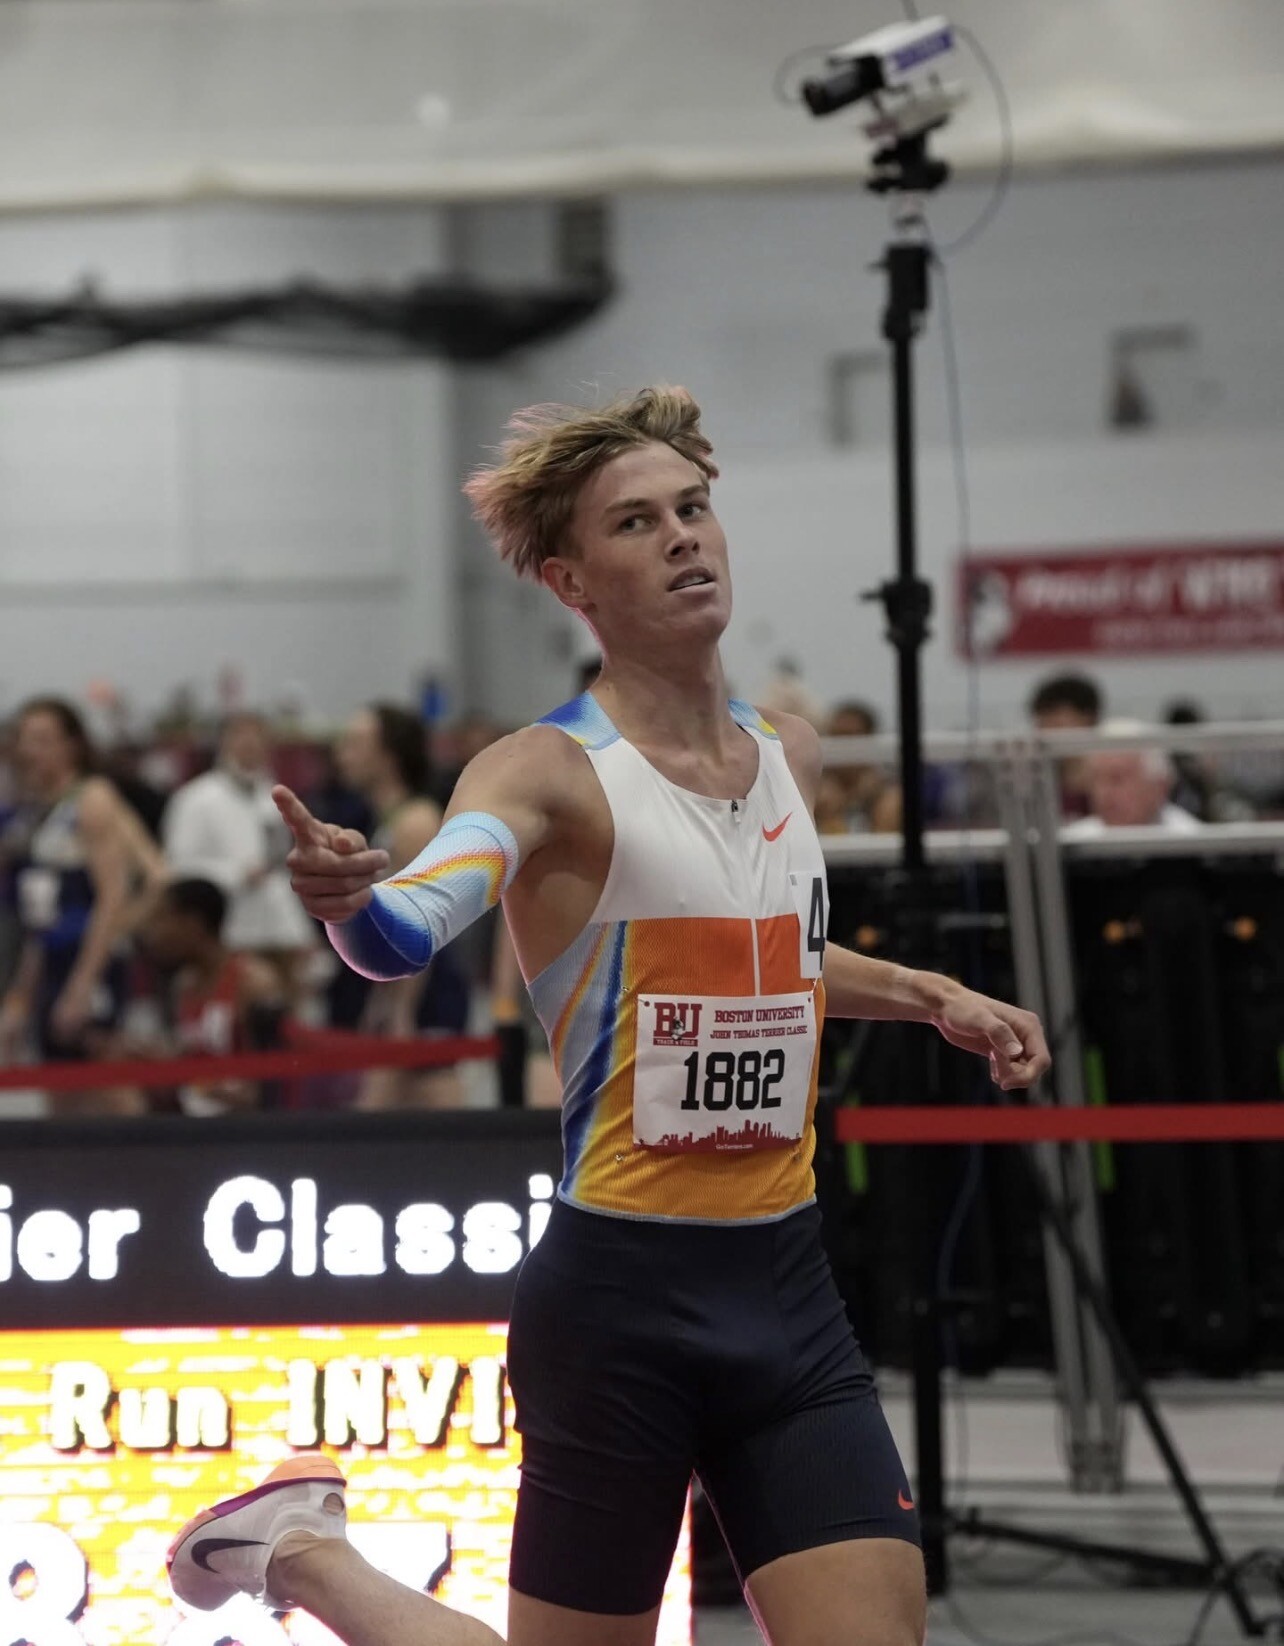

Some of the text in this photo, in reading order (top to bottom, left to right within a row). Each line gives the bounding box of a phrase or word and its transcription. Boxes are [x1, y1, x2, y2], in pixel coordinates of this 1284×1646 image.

[807, 877, 825, 971] 4
[653, 1002, 702, 1039] BU
[710, 1030, 731, 1039] JOHN
[733, 1029, 760, 1039] THOMAS
[715, 1006, 804, 1023] BOSTON UNIVERSITY
[681, 1049, 785, 1111] 1882
[50, 1356, 502, 1450] Run INVI
